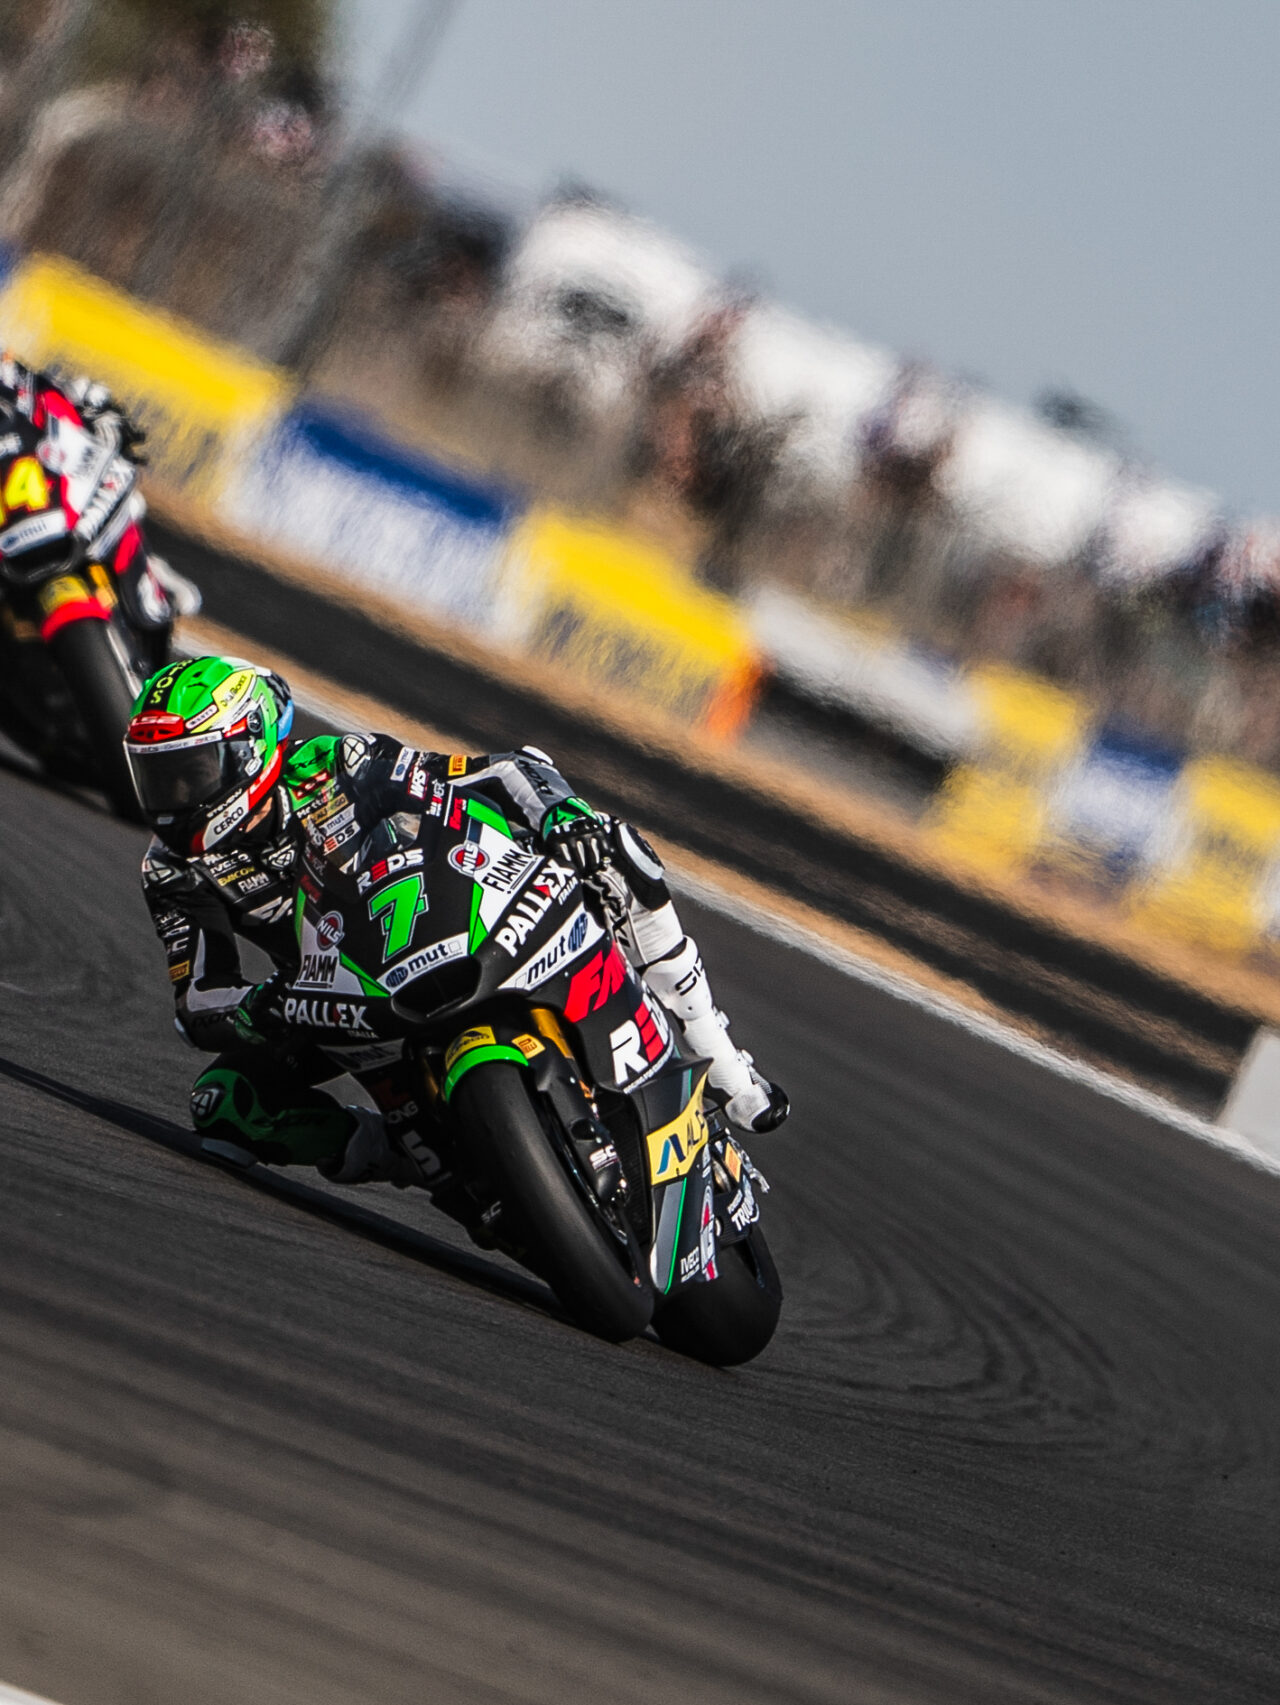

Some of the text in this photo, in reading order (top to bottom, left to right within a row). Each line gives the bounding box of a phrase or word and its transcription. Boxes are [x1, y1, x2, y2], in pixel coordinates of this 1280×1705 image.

[213, 806, 244, 835] CERCO
[323, 823, 356, 854] EDS
[356, 848, 425, 896] REDS
[462, 842, 480, 875] NILS
[367, 871, 430, 965] 7
[494, 858, 576, 958] PALLEX
[318, 918, 343, 943] NILS
[300, 953, 338, 983] FIAMM
[408, 943, 449, 973] mut
[526, 935, 567, 985] mut
[284, 997, 374, 1031] PALLEX
